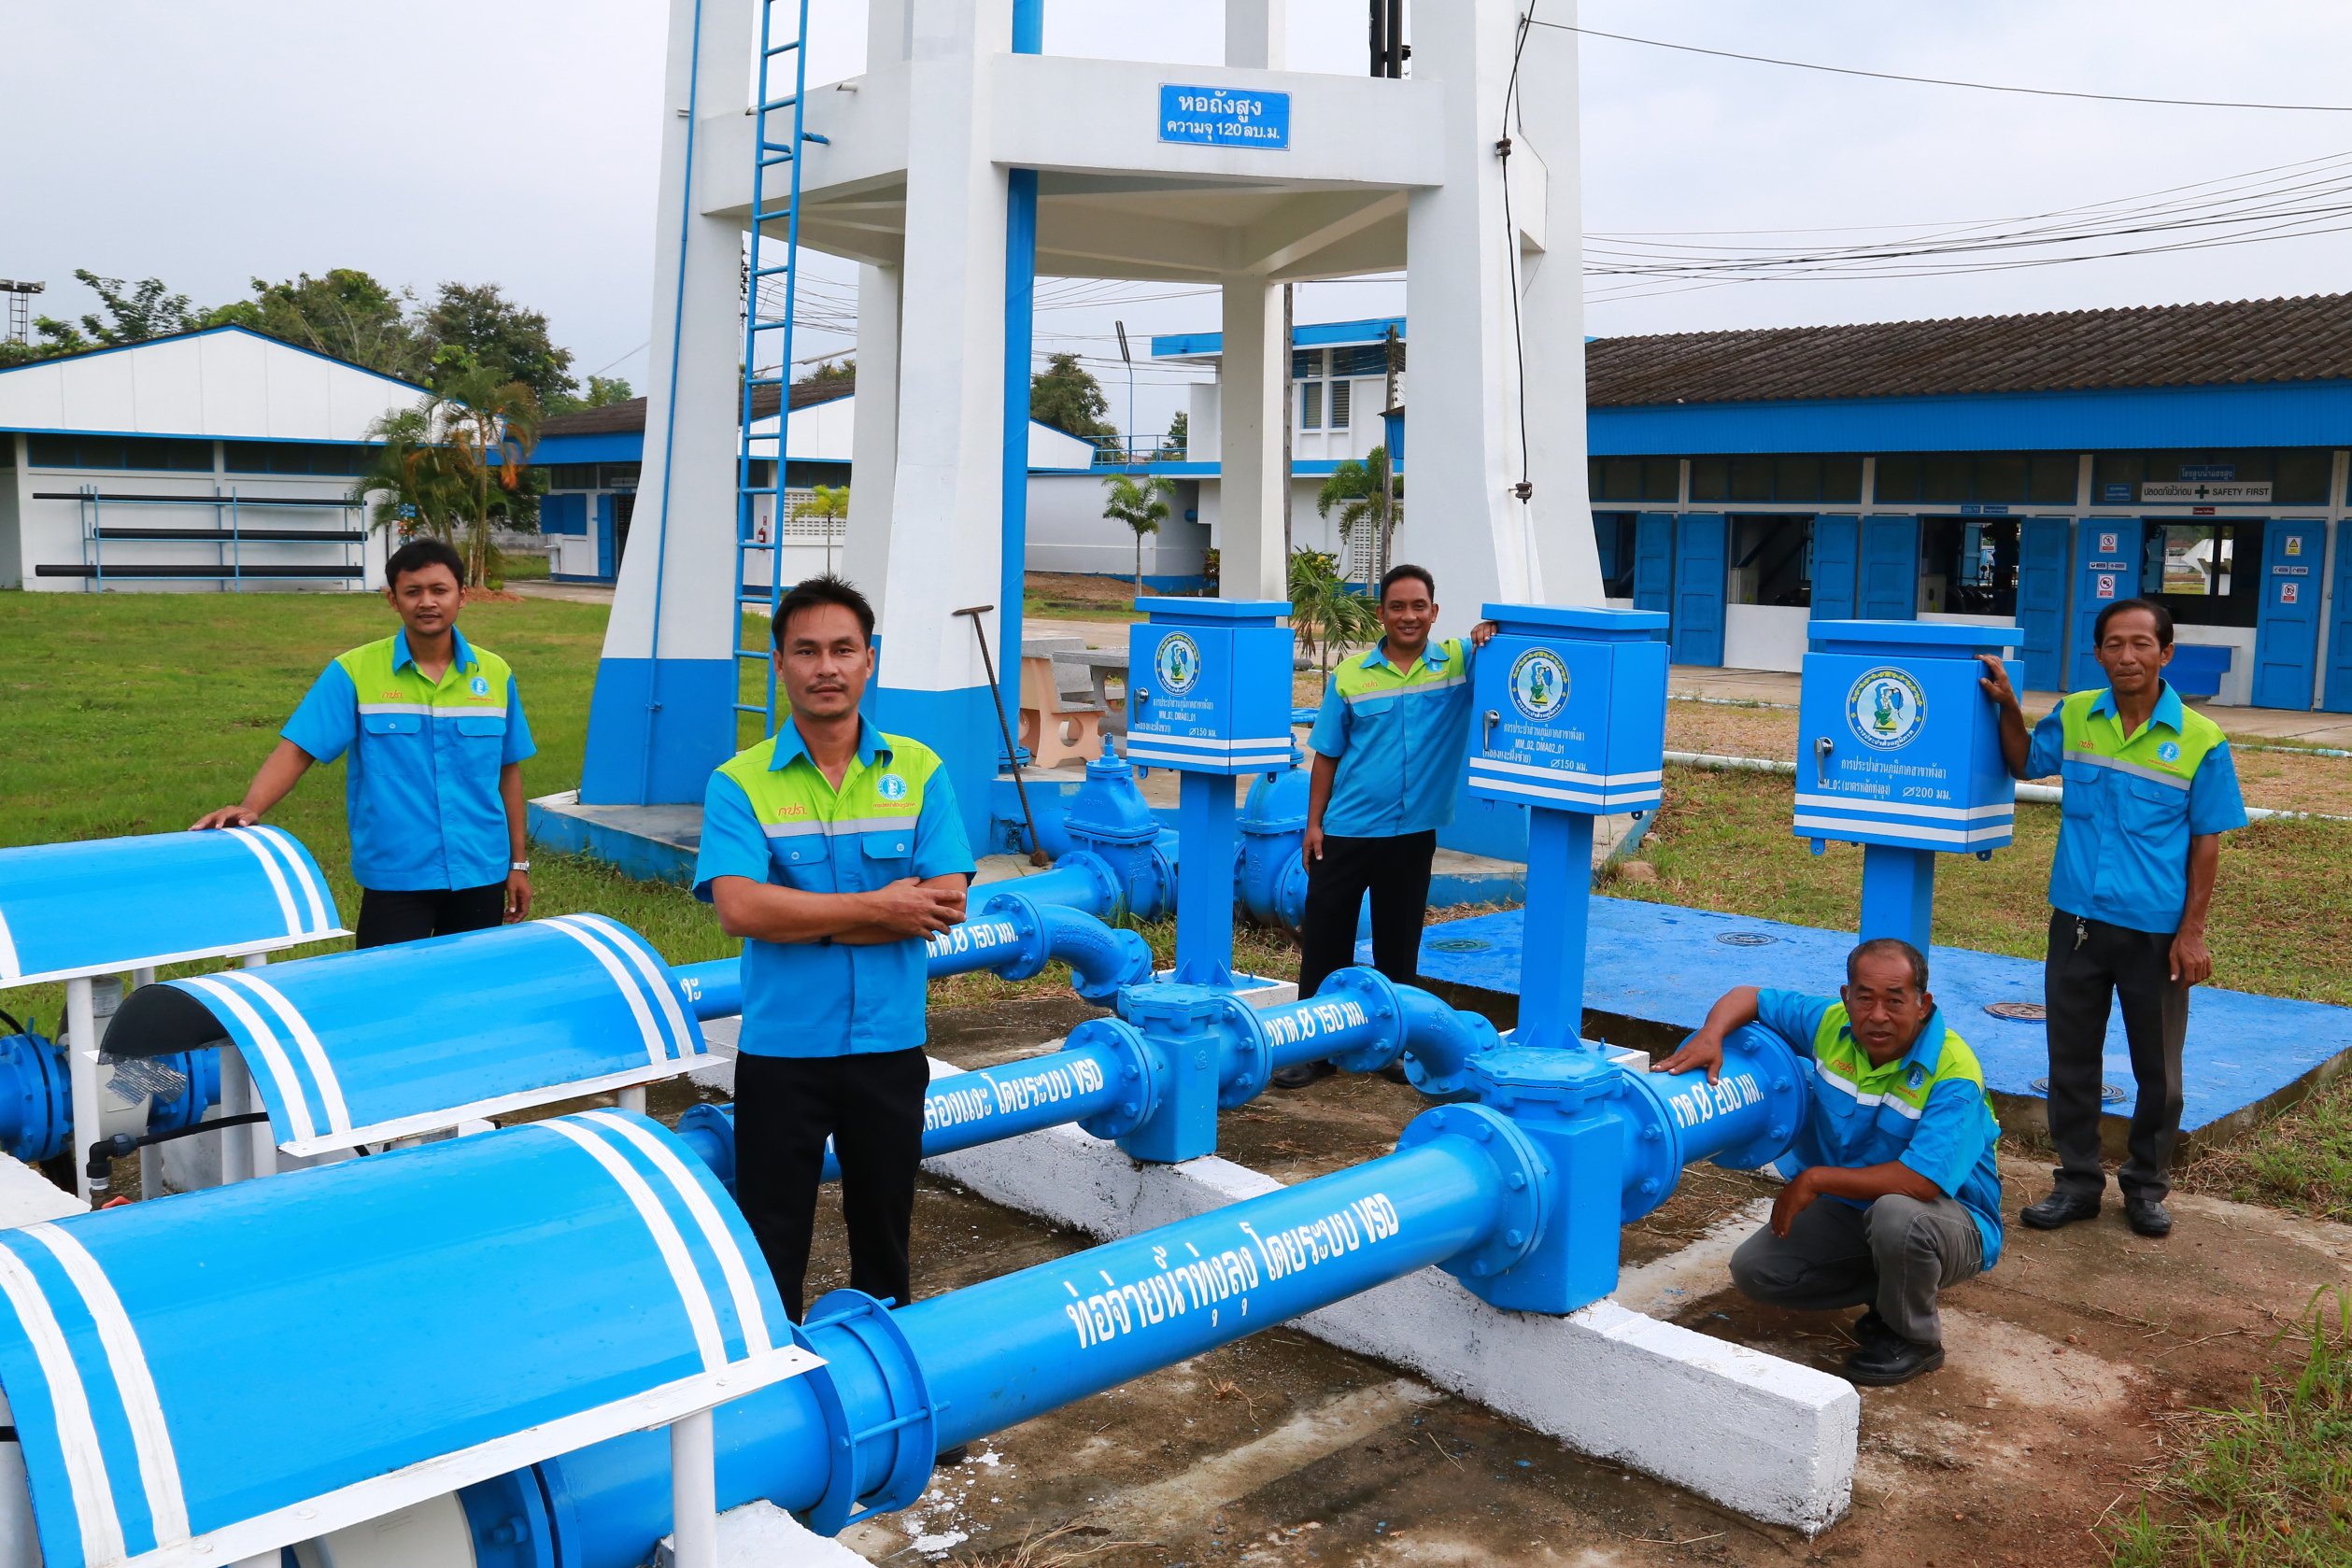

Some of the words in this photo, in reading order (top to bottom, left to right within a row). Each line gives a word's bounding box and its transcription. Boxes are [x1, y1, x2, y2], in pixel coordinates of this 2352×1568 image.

[1178, 90, 1262, 123] หอถังสูง
[1167, 120, 1213, 141] ความจุ
[1216, 122, 1242, 136] 120
[1243, 126, 1281, 139] ลบ.ม.
[2144, 485, 2192, 496] ปลอดภัยไว้ก่อน
[2212, 487, 2243, 496] SAFETY
[2246, 487, 2270, 496] FIRST
[968, 924, 997, 950] 150
[1312, 1003, 1345, 1035] 150
[1339, 1000, 1369, 1028] มม.
[923, 1087, 993, 1133] ลองแงะ
[979, 1067, 1072, 1115] โดยระบบ
[1066, 1057, 1104, 1095] VSD
[1707, 1077, 1743, 1116] 200
[1735, 1073, 1764, 1106] มม.
[1063, 1241, 1260, 1349] ท่อจ่ายน้ำทุ่งลุง
[1239, 1221, 1360, 1282] โดยระบบ
[1350, 1192, 1400, 1244] VSD
